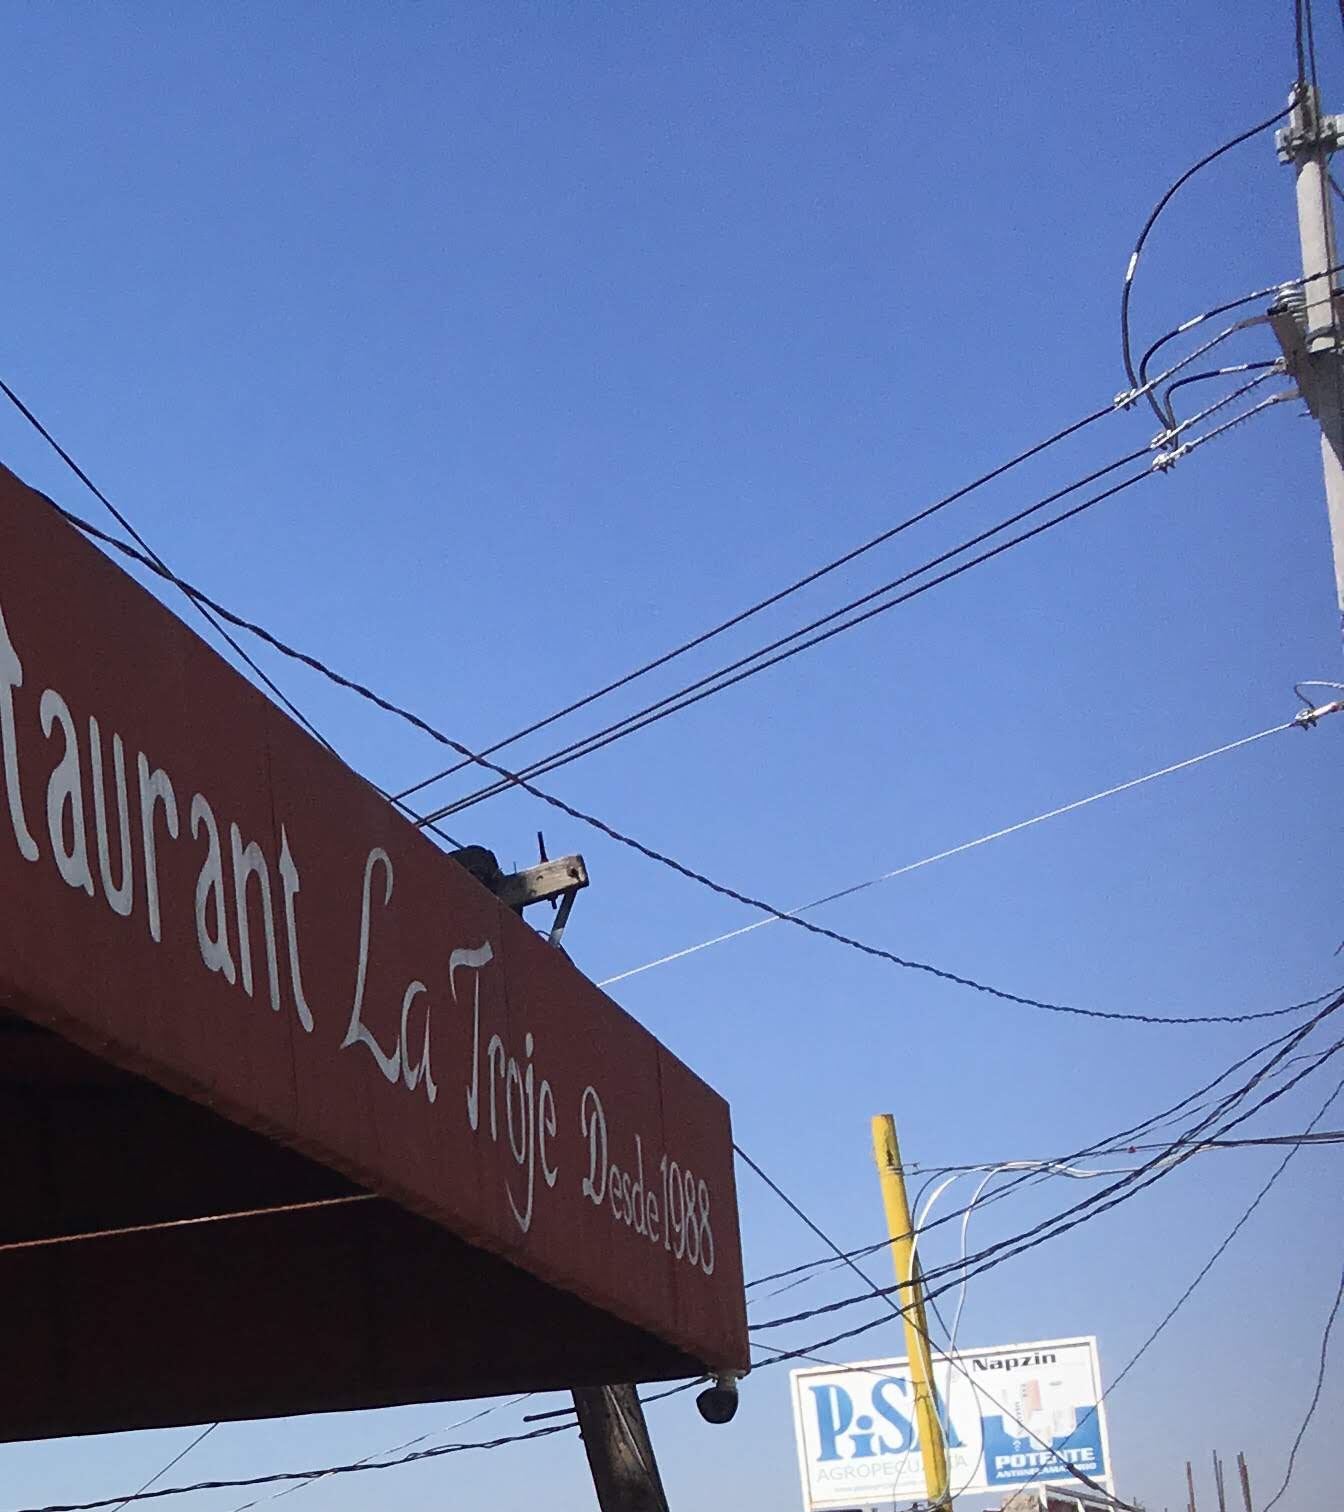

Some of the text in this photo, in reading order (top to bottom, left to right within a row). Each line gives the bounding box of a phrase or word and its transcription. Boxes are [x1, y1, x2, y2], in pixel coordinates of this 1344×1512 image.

[340, 847, 437, 1104] La
[449, 939, 558, 1232] Troje
[581, 1085, 660, 1242] Desde
[660, 1154, 714, 1276] 1988
[972, 1352, 1056, 1371] Napzin
[995, 1447, 1096, 1470] POTENTE
